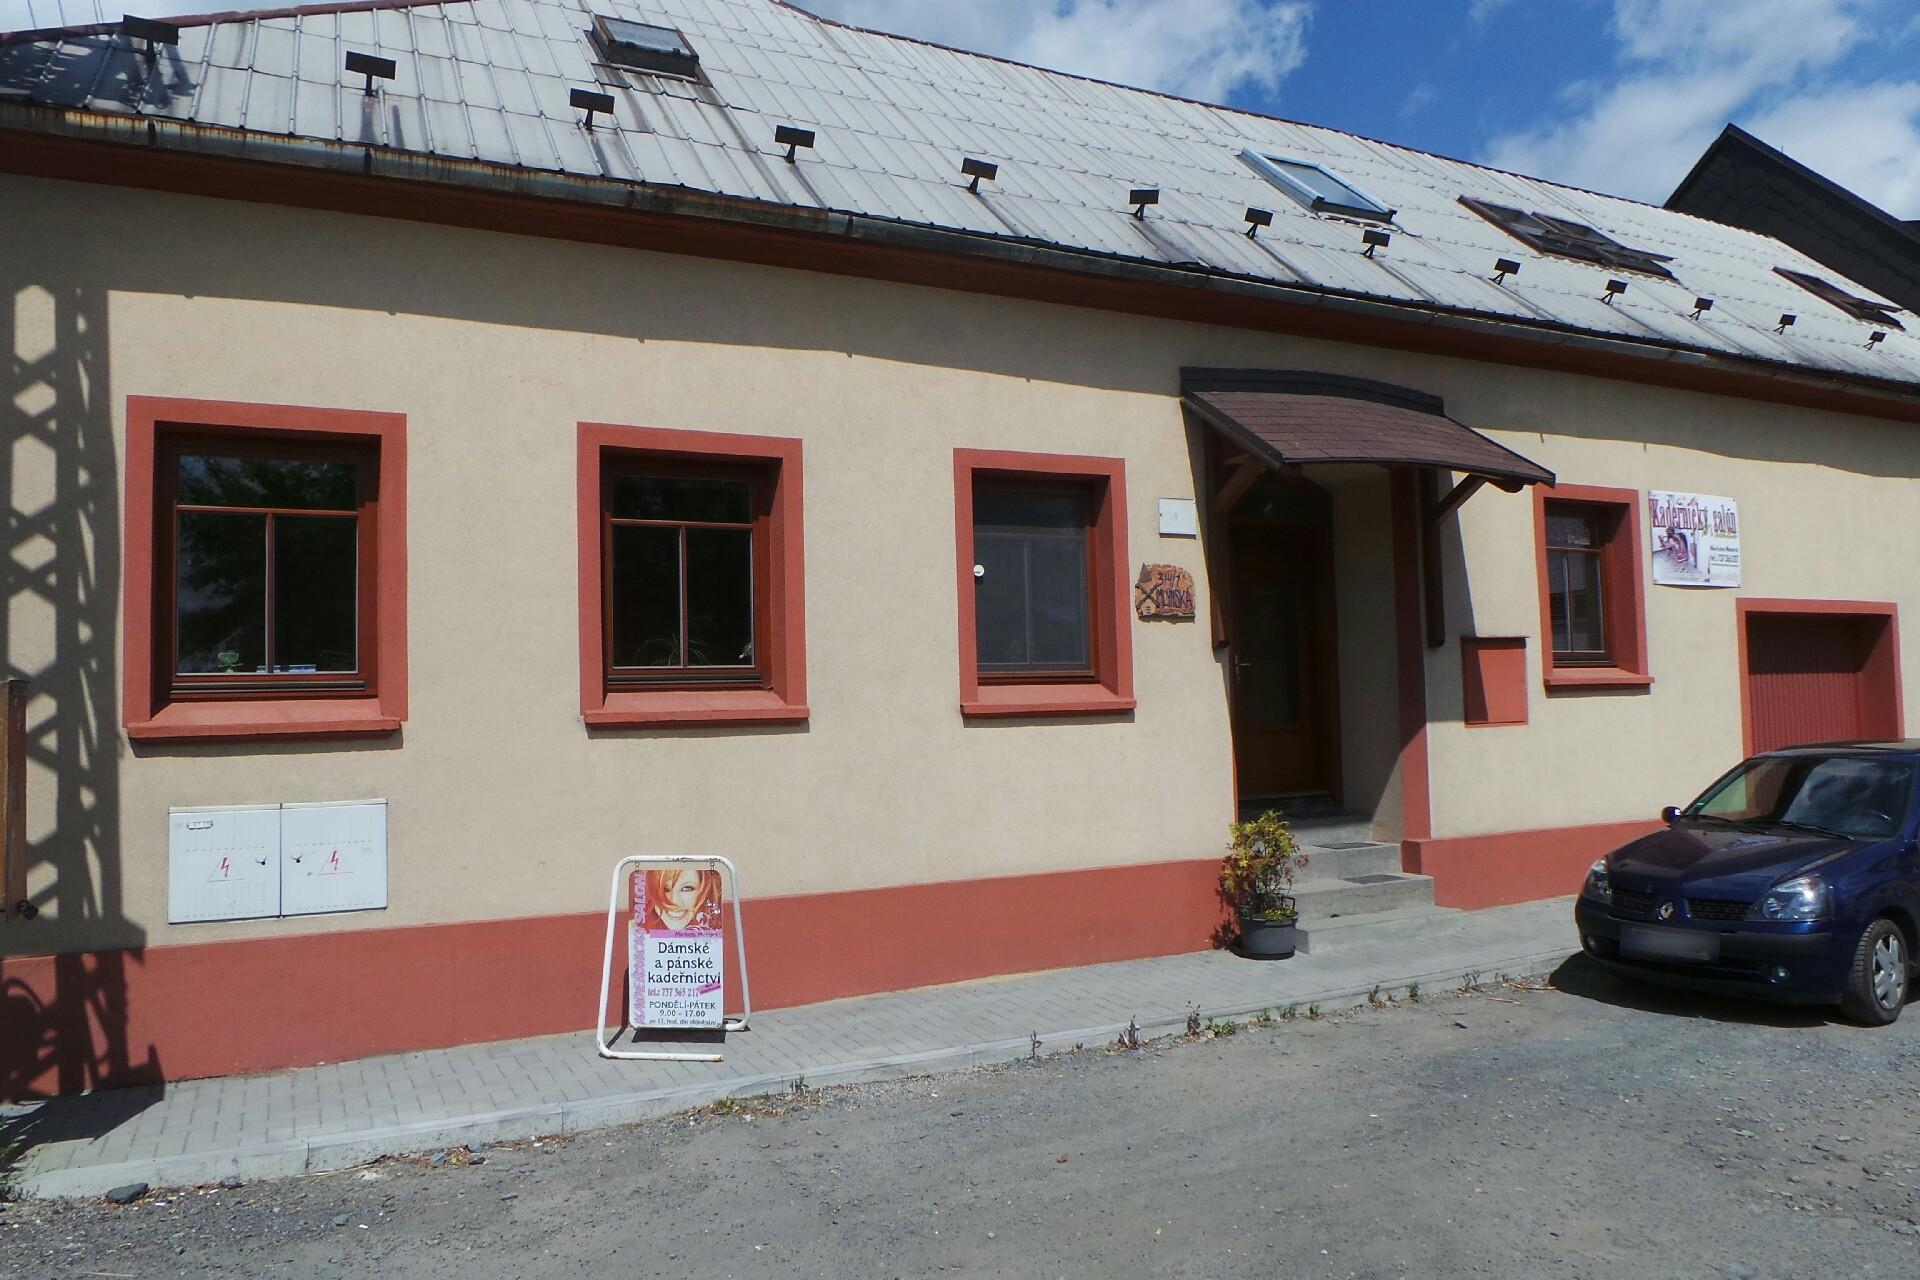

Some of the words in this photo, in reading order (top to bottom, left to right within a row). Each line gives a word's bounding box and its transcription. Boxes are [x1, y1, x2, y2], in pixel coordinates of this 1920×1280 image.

[1712, 504, 1737, 534] salón
[657, 941, 710, 954] Dámské
[654, 959, 663, 969] a
[666, 956, 713, 971] pánské
[649, 999, 716, 1010] PONDĚLÍ-PÁTEK
[659, 1009, 677, 1017] 9.00
[685, 1009, 706, 1018] 17.00
